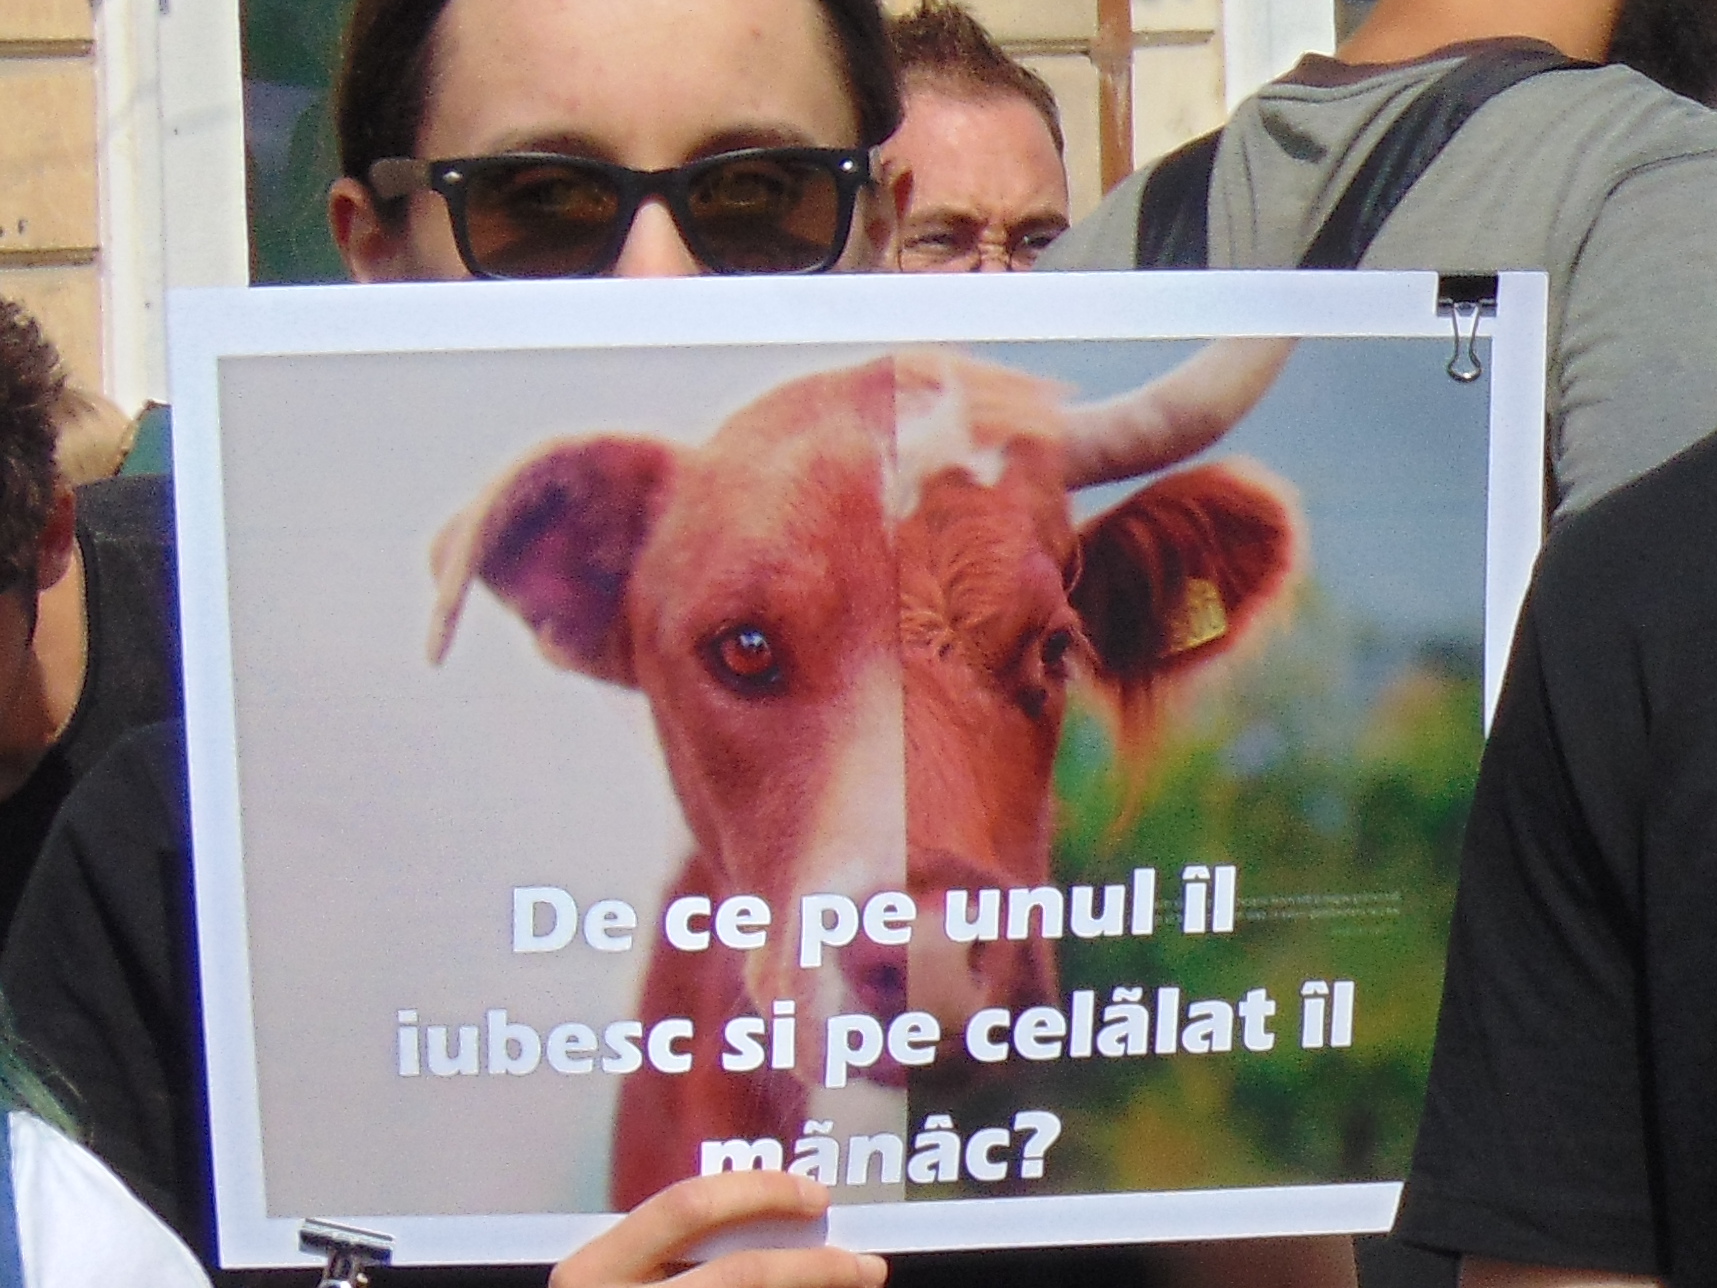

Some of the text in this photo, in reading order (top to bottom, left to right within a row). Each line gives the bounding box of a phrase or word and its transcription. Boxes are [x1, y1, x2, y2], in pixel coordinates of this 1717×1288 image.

[512, 885, 638, 953] De
[664, 894, 772, 951] ce
[799, 890, 917, 968] pe
[944, 867, 1157, 943] unul
[1181, 864, 1238, 934] îl
[397, 1008, 694, 1077] iubesc
[721, 1000, 796, 1072] si
[824, 1009, 941, 1089] pe
[1299, 979, 1356, 1049] îl
